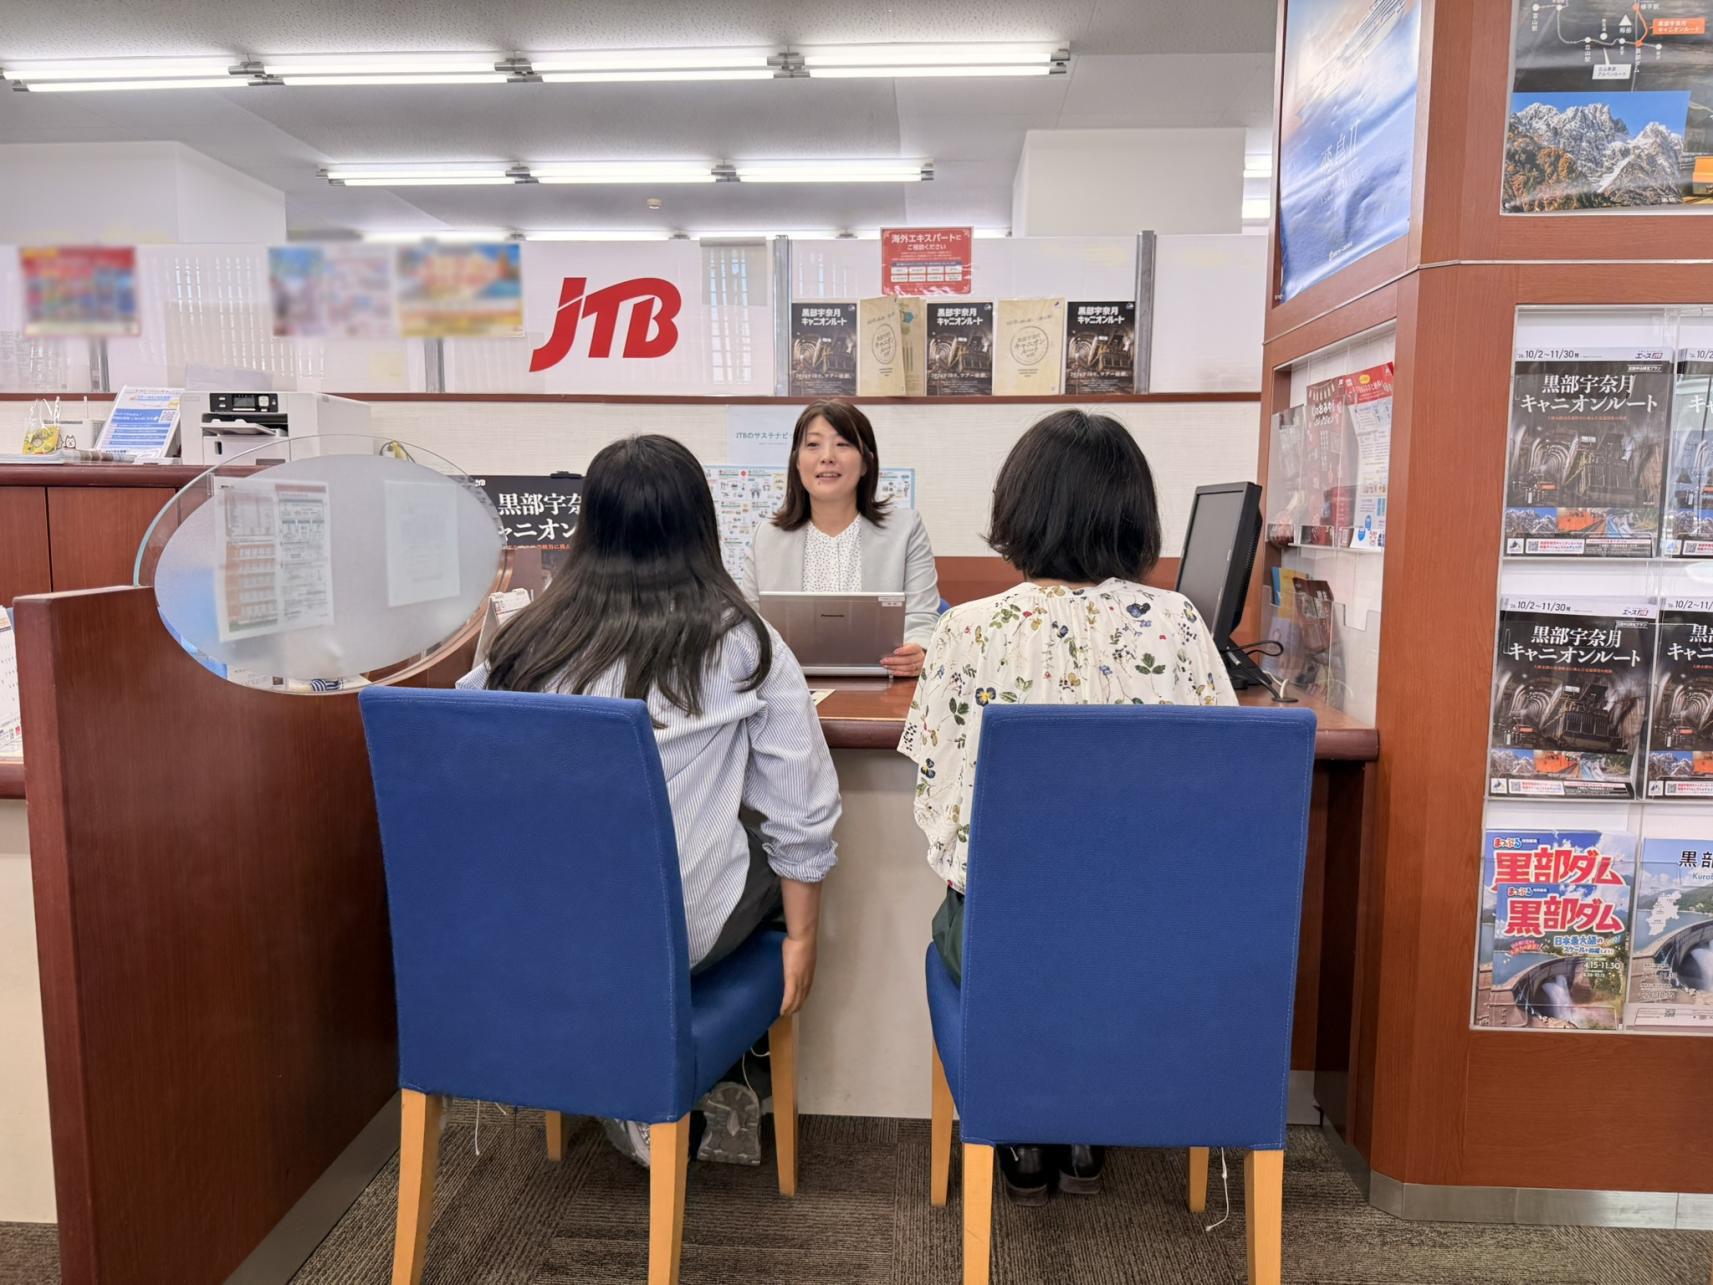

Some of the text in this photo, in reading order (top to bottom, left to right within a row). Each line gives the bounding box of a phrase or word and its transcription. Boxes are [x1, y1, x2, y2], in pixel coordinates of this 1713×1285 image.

[891, 233, 962, 243] 海外エキスパートに
[801, 308, 841, 317] 黒部宇奈月
[937, 308, 977, 317] 黒部宇奈月
[1077, 306, 1119, 316] 黒部宇奈月
[529, 277, 682, 372] JTB
[801, 318, 847, 326] キャニオンルート
[937, 317, 983, 326] キャニオンルート
[1077, 315, 1125, 325] キャニオンルート
[1542, 374, 1634, 395] 黒部宇奈月
[1520, 394, 1658, 413] キャニオンルート
[1531, 625, 1622, 648] 黒部宇奈月
[1509, 642, 1641, 668] キャニオンルート
[1490, 846, 1624, 888] 黒部ダム
[1504, 895, 1625, 936] 黒部ダム
